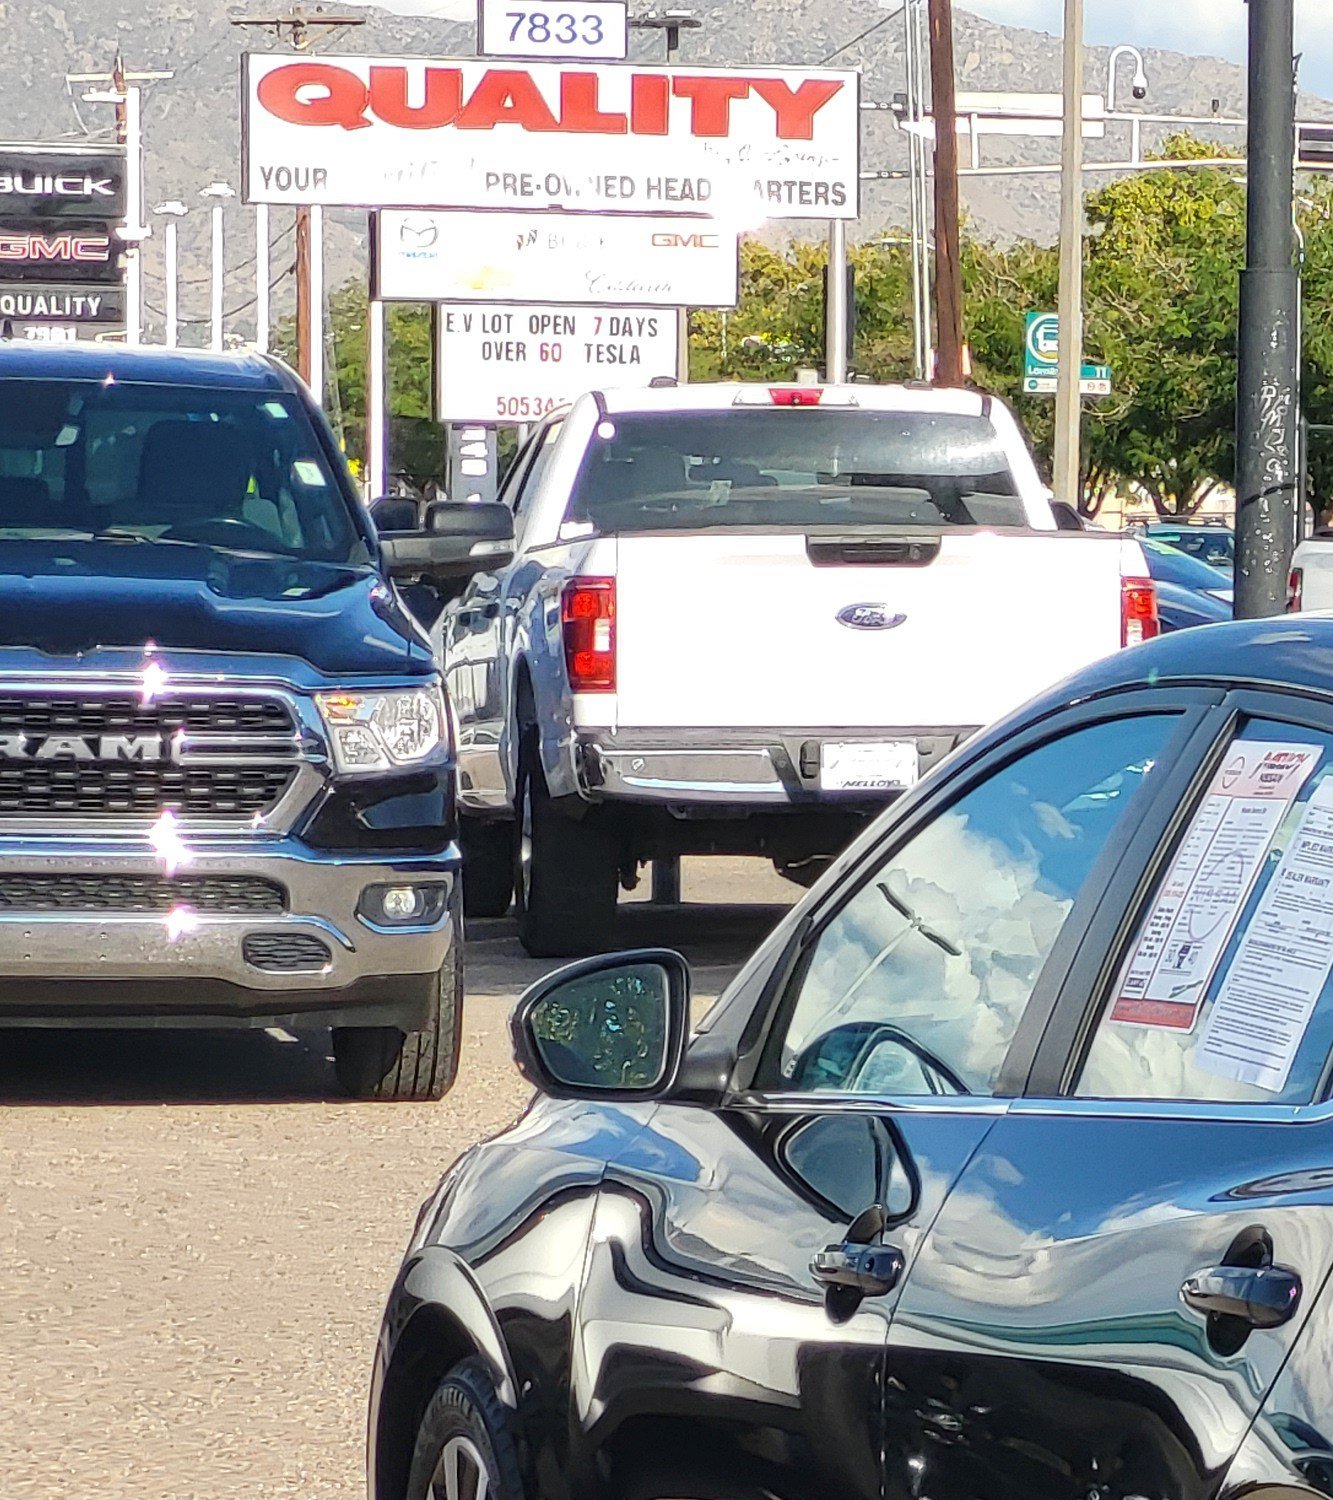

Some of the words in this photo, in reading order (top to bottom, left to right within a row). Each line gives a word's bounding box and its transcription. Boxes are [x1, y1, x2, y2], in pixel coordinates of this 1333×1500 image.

[506, 12, 604, 45] 7833
[257, 62, 845, 140] QUALITY
[0, 176, 116, 195] BUICK
[260, 166, 328, 191] YOUR
[486, 171, 636, 199] PRE-OED
[646, 177, 846, 206] HEADARTERS
[0, 235, 110, 261] GMC
[652, 233, 719, 247] GMC
[1, 295, 101, 317] QUALITY
[482, 313, 514, 334] LOT
[529, 314, 576, 336] OPEN
[594, 316, 603, 336] 7
[609, 317, 658, 337] DAYS
[482, 341, 527, 362] OVER
[539, 342, 562, 362] 60
[584, 343, 641, 365] TESLA
[496, 396, 556, 416] 50534
[0, 734, 162, 760] RAM
